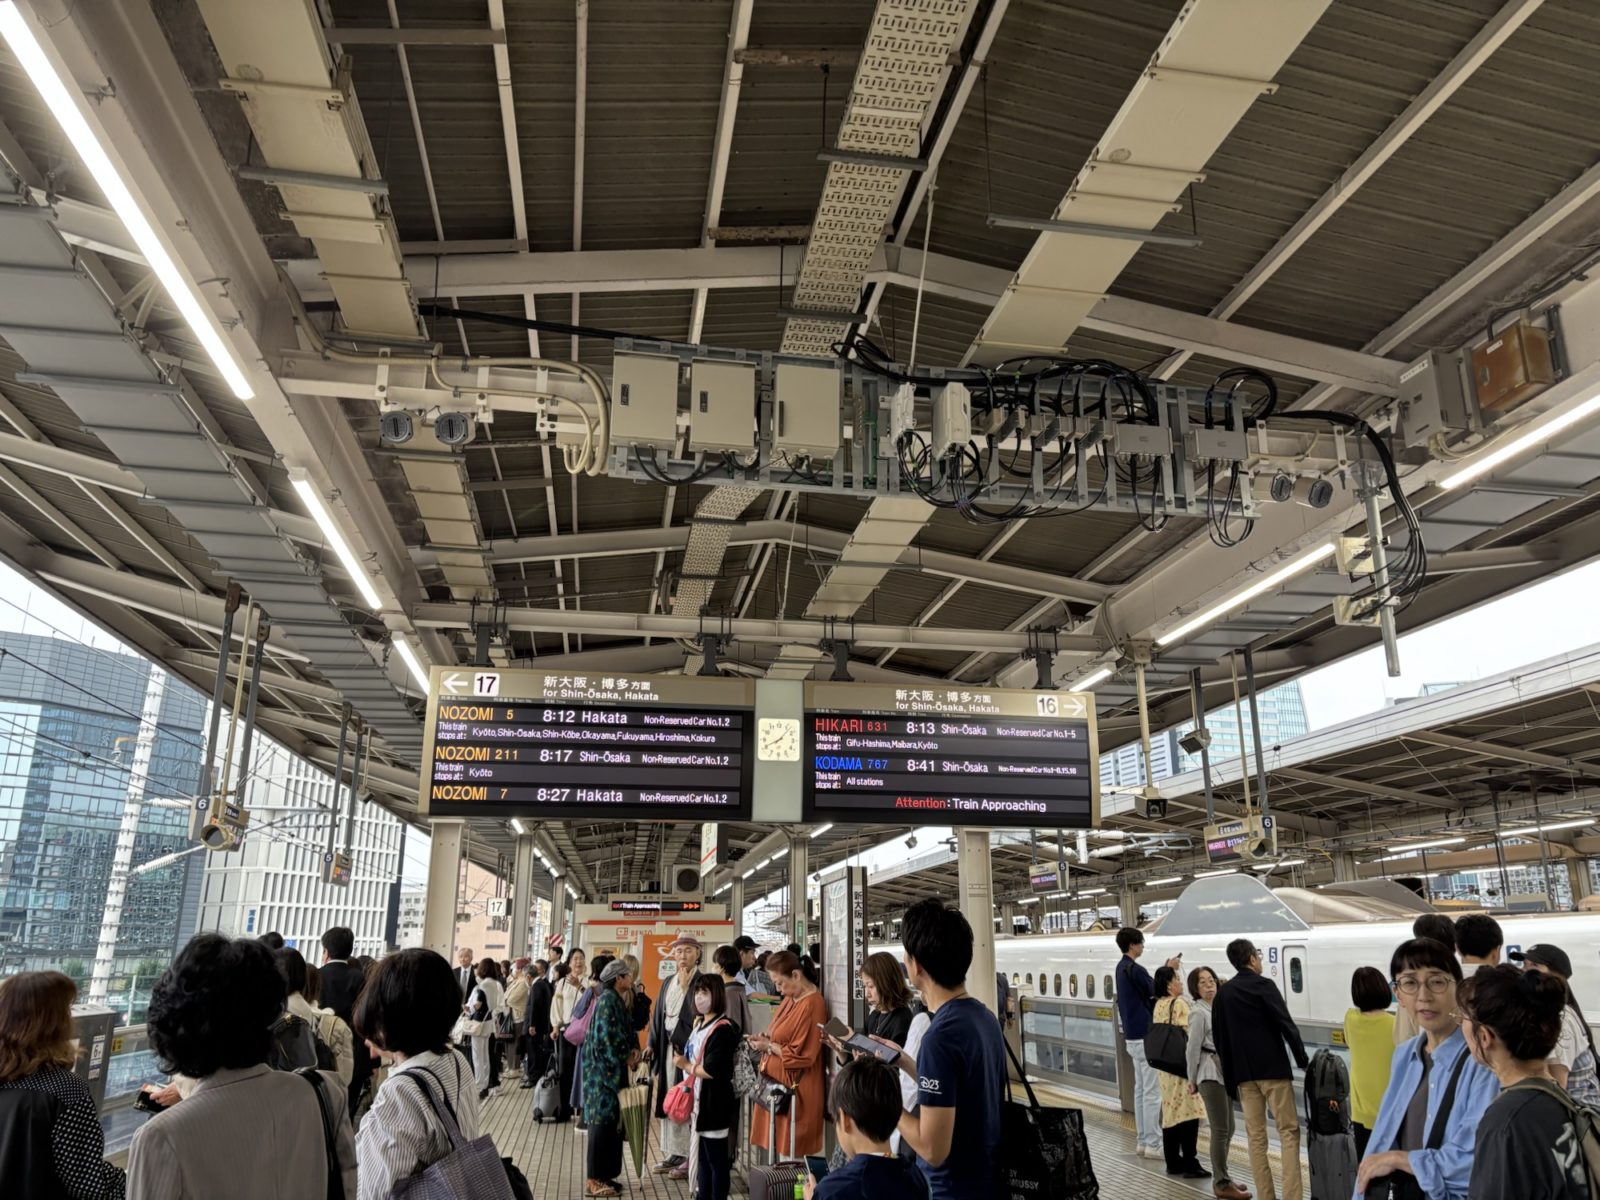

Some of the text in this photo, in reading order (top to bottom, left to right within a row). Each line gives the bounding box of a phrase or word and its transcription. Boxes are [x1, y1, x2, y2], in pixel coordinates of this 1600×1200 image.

[477, 676, 496, 693] 17
[543, 688, 557, 697] for
[624, 691, 659, 701] Hakata
[896, 702, 909, 710] for
[969, 704, 1000, 713] Hakata
[1039, 698, 1056, 714] 16
[439, 706, 494, 720] NOZOMI
[506, 709, 514, 720] 5
[543, 710, 575, 723] 8:12
[582, 711, 628, 724] Hakata
[439, 722, 468, 731] This train
[815, 718, 863, 732] HIKARI
[867, 721, 887, 732] 631
[906, 721, 935, 734] 8:13
[438, 732, 456, 740] stops
[815, 733, 842, 742] This train
[435, 747, 490, 761] NOZOMI
[495, 749, 518, 760] 211
[540, 749, 573, 762] 8:17
[435, 762, 464, 772] This train
[815, 756, 863, 770] KODAMA
[868, 759, 888, 769] 767
[907, 759, 935, 772] 8:41
[434, 772, 452, 781] stops
[815, 771, 841, 780] This train
[846, 777, 884, 787] All stations
[432, 785, 488, 800] NOZOMI
[500, 788, 508, 799] 7
[537, 788, 570, 802] 8:27
[576, 789, 623, 802] Hakata
[198, 799, 207, 809] 6
[952, 798, 978, 809] Train
[981, 799, 1047, 812] Approaching
[1264, 818, 1271, 828] 6
[325, 854, 332, 862] 5
[491, 901, 503, 912] 17
[1270, 949, 1276, 962] 5
